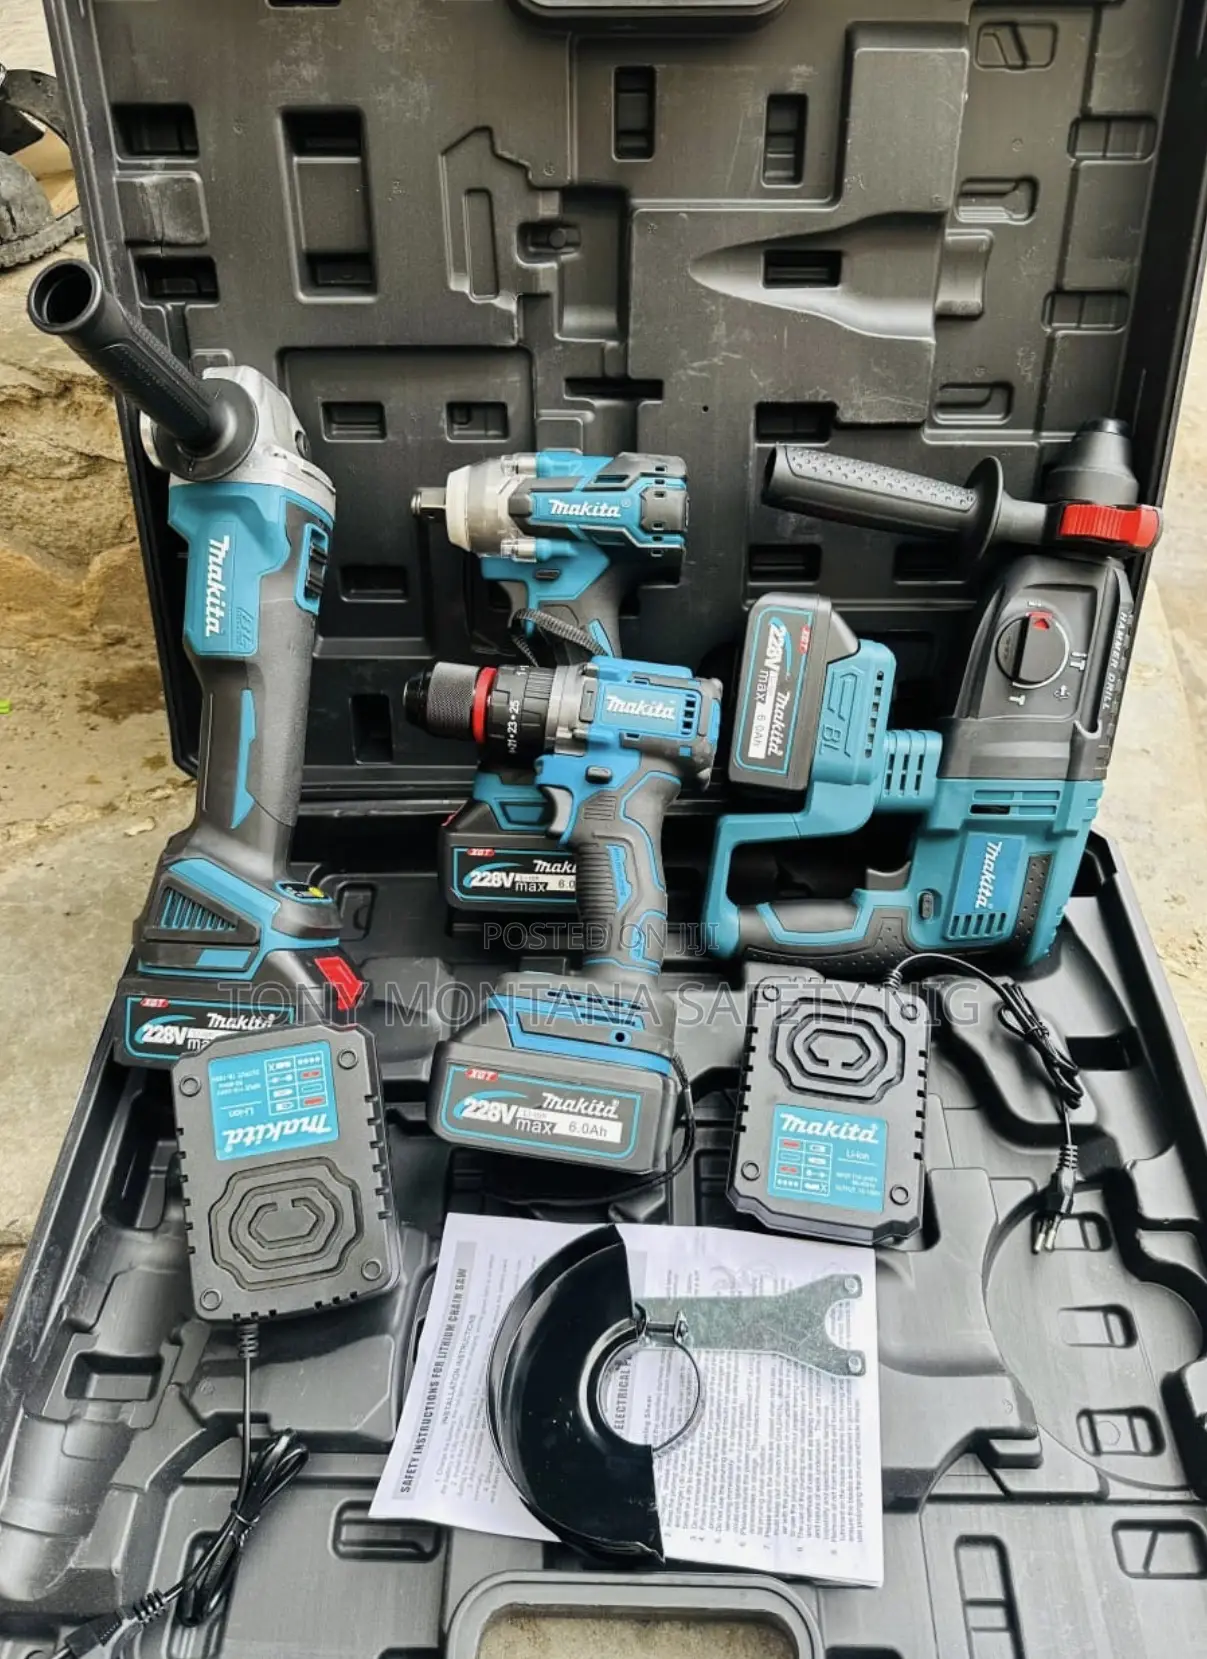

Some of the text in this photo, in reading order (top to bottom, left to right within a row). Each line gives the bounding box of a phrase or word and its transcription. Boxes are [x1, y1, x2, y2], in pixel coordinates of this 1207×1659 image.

[763, 624, 788, 673] 228V
[1102, 612, 1128, 710] HAMMER DRILL
[755, 669, 769, 705] max
[819, 724, 841, 755] BL
[469, 870, 546, 893] 228V max
[142, 1023, 188, 1045] 228V
[187, 1037, 212, 1050] ma
[462, 1096, 519, 1125] 228V
[515, 1117, 554, 1135] max
[568, 1121, 608, 1138] 6.0Ah
[400, 1268, 467, 1493] SAFETY INSTRUCTIONS FOR LITHIUM CHAIN SAW
[442, 1368, 461, 1425] INSTALLATION
[613, 1370, 630, 1430] ELECTRICAL
